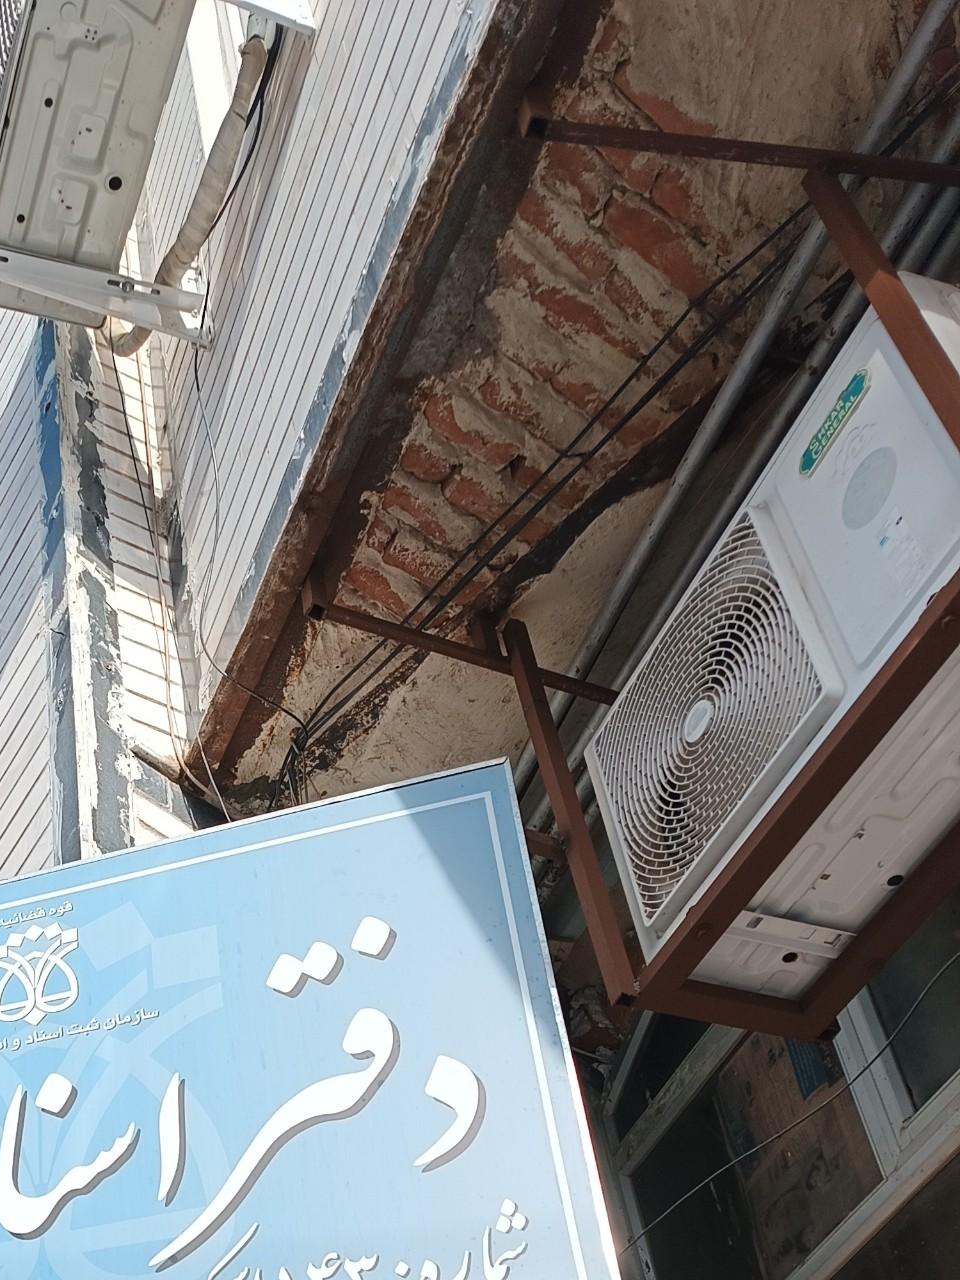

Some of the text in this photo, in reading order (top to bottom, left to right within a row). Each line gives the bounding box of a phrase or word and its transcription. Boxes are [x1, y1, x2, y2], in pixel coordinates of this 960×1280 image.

[812, 395, 858, 459] GENERAL
[46, 900, 74, 918] قوه
[66, 1019, 100, 1037] ثبت
[103, 1008, 160, 1031] سازمان
[11, 1038, 22, 1051] و
[25, 1027, 64, 1046] اسناد
[152, 915, 488, 1274] دفتر
